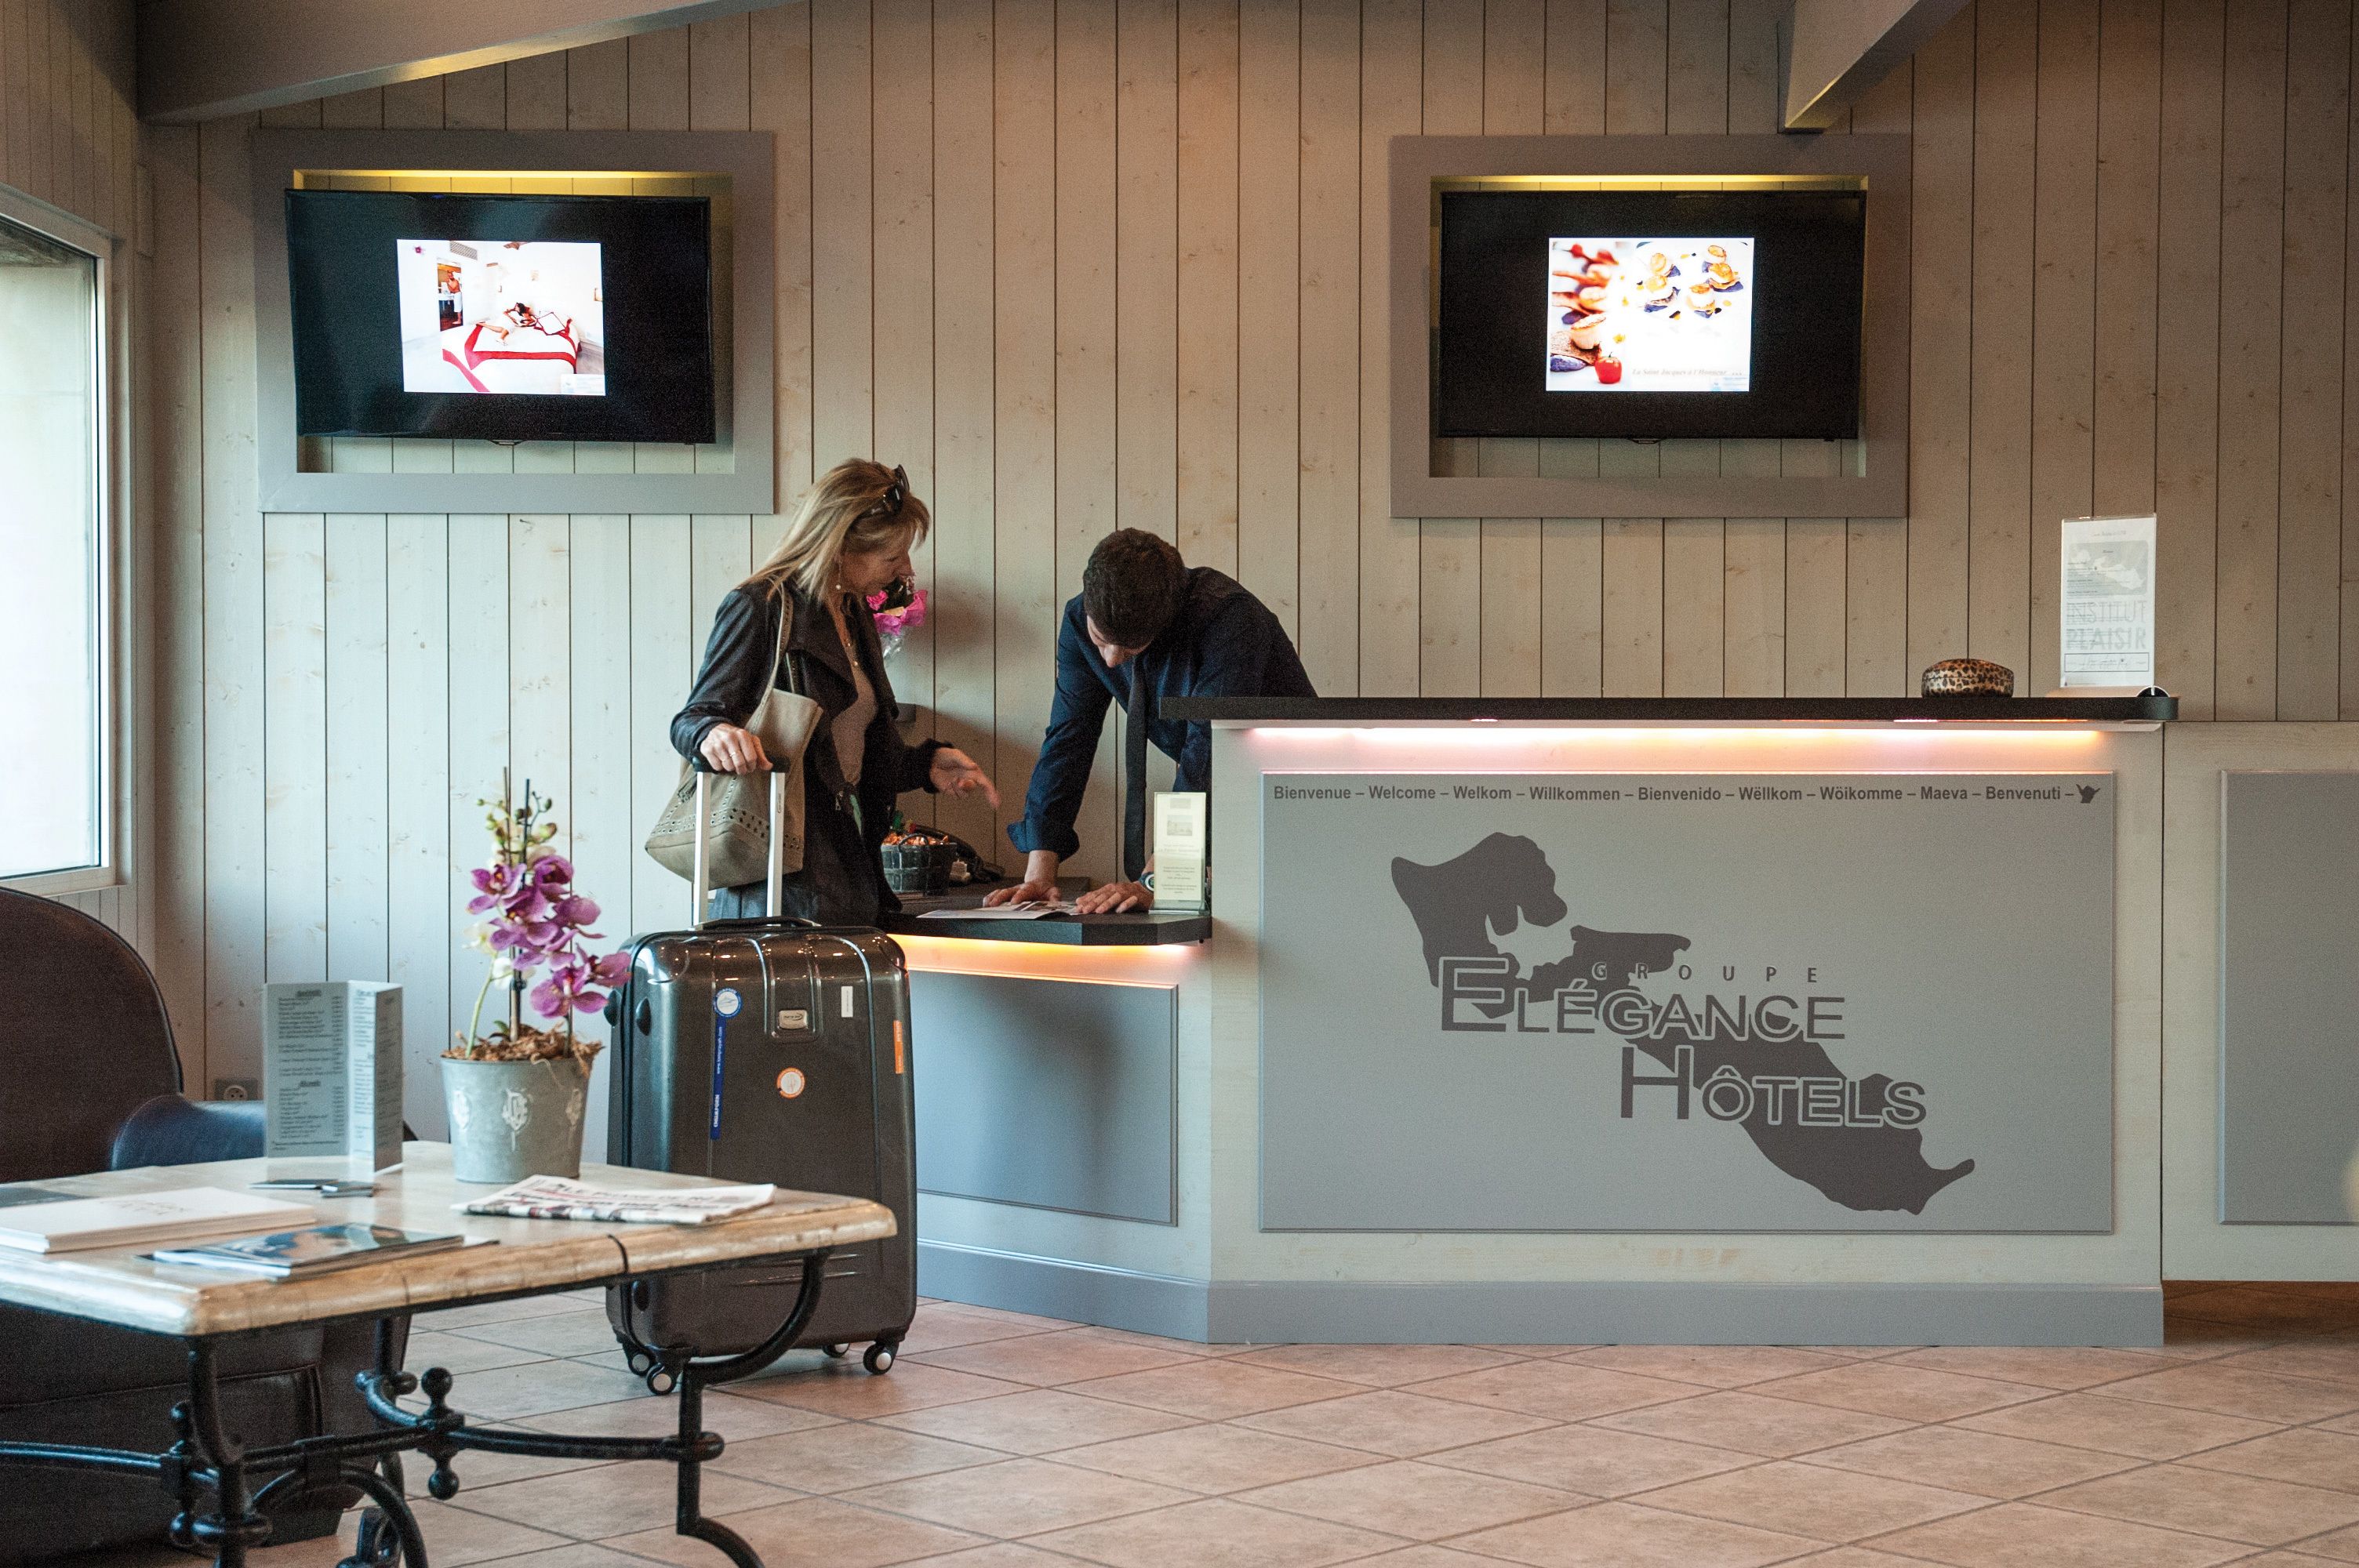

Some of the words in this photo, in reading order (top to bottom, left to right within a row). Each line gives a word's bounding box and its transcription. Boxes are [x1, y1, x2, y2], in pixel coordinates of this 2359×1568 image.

[1274, 786, 1351, 800] Bienvenue
[1369, 786, 1436, 800] Welcome
[1453, 786, 1512, 800] Welkom
[1529, 786, 1620, 800] Willkommen
[1638, 786, 1721, 800] Bienvenido
[1739, 786, 1802, 800] Wëllkom
[1921, 786, 1968, 800] Maeva
[1986, 786, 2060, 800] Benvenuti
[1591, 960, 1818, 984] GROUPE
[1620, 1045, 1927, 1130] HÔTELS
